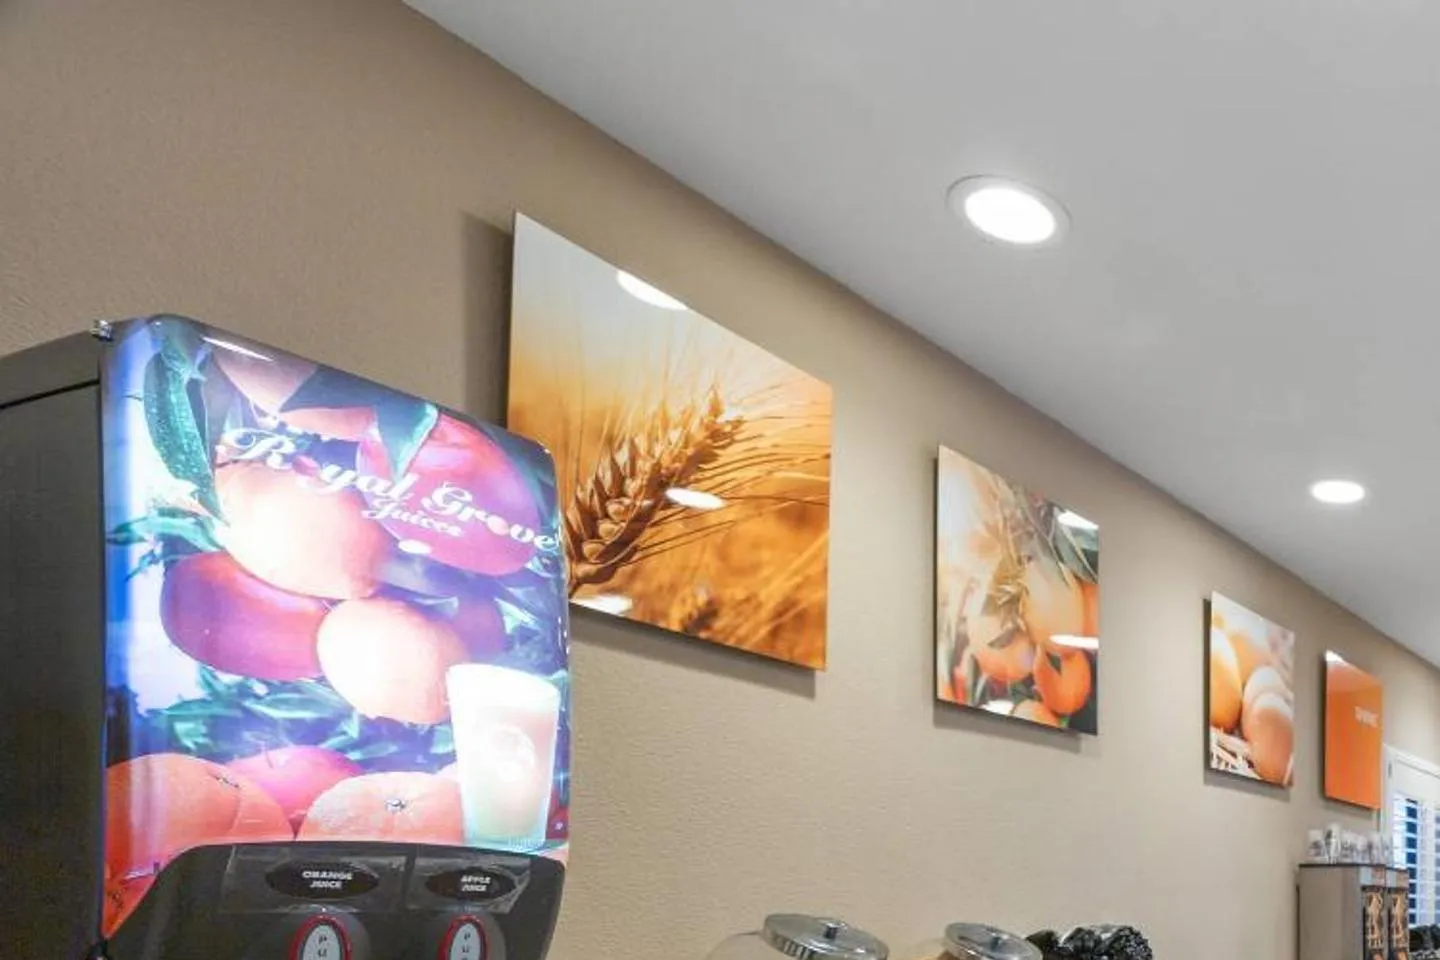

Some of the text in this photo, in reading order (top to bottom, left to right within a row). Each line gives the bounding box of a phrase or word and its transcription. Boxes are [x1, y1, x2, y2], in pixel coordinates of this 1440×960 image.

[215, 427, 420, 500] Royal
[302, 871, 353, 881] ORANGE
[461, 874, 491, 884] APPLE
[310, 880, 342, 889] JUICE
[461, 884, 487, 892] JUICE
